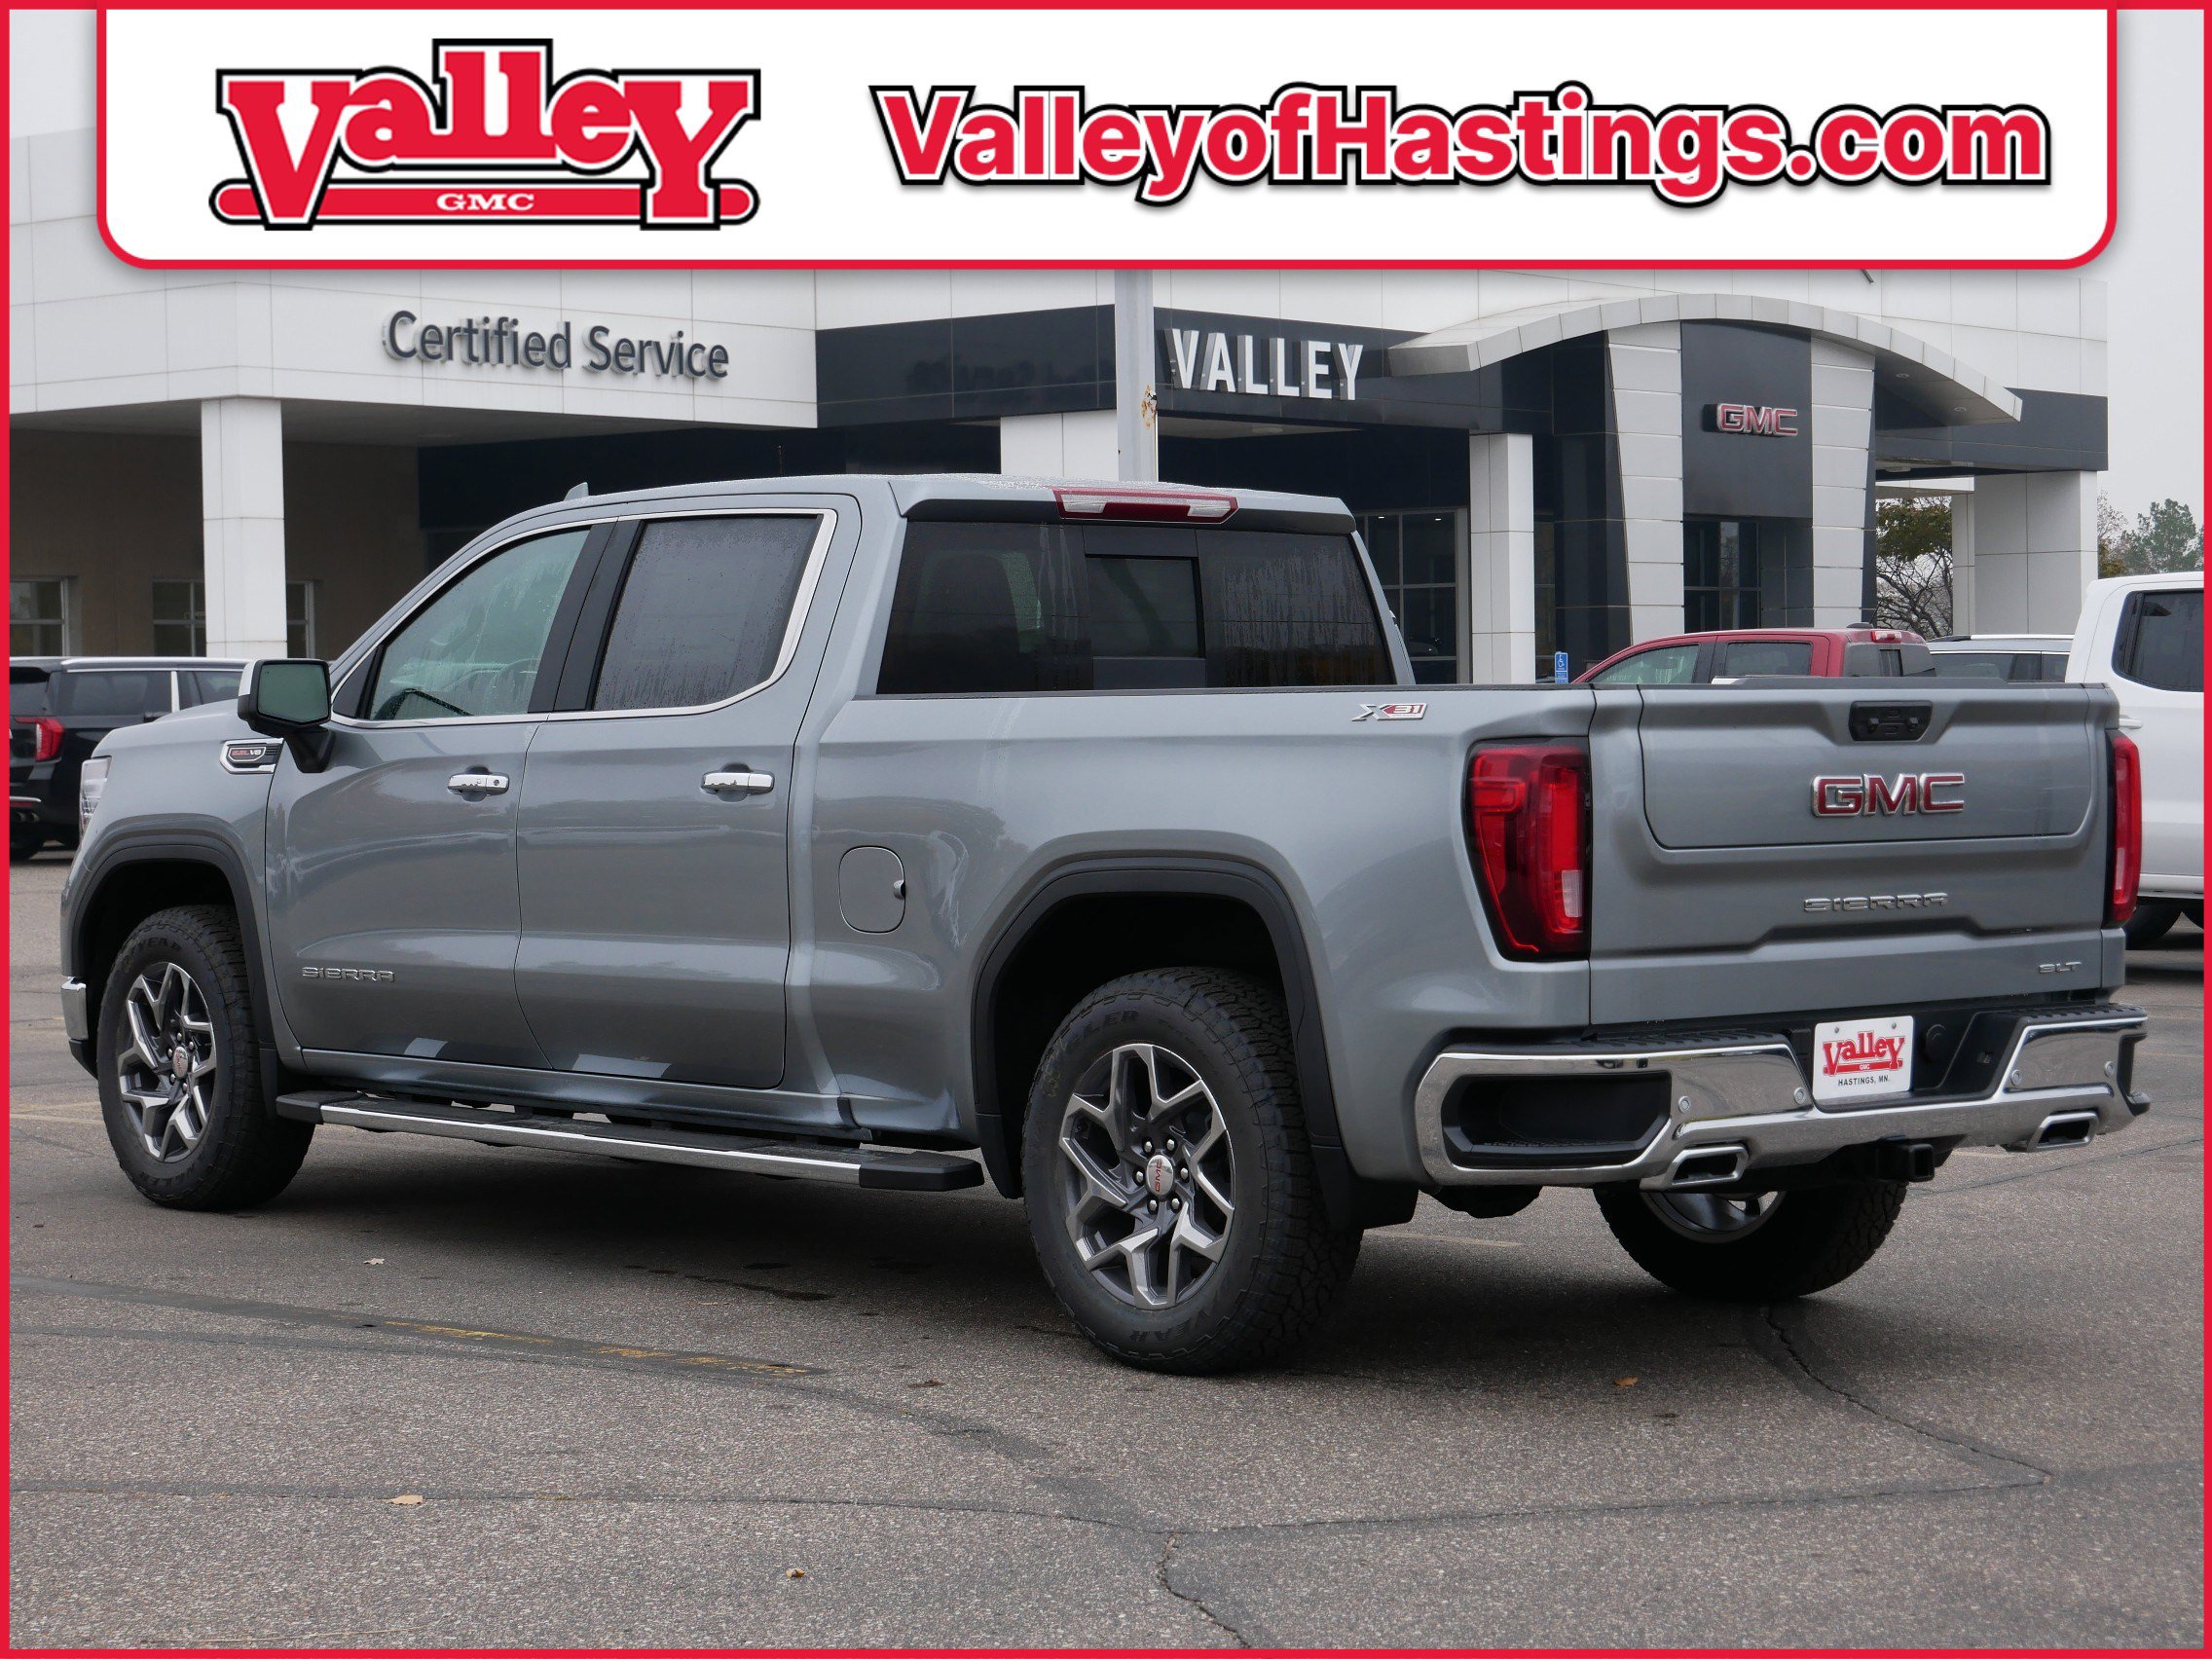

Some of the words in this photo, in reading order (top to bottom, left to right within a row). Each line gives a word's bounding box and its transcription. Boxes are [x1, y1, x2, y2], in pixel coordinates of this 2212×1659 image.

[386, 310, 571, 370] Certified
[584, 325, 729, 379] Service
[1164, 328, 1363, 400] VALLEY
[1716, 403, 1798, 436] GMC
[1351, 703, 1428, 721] X31
[1811, 772, 1965, 816] GMC
[1803, 892, 1948, 912] SIERRA
[302, 967, 395, 982] SIERRA
[2039, 961, 2083, 974] SLT
